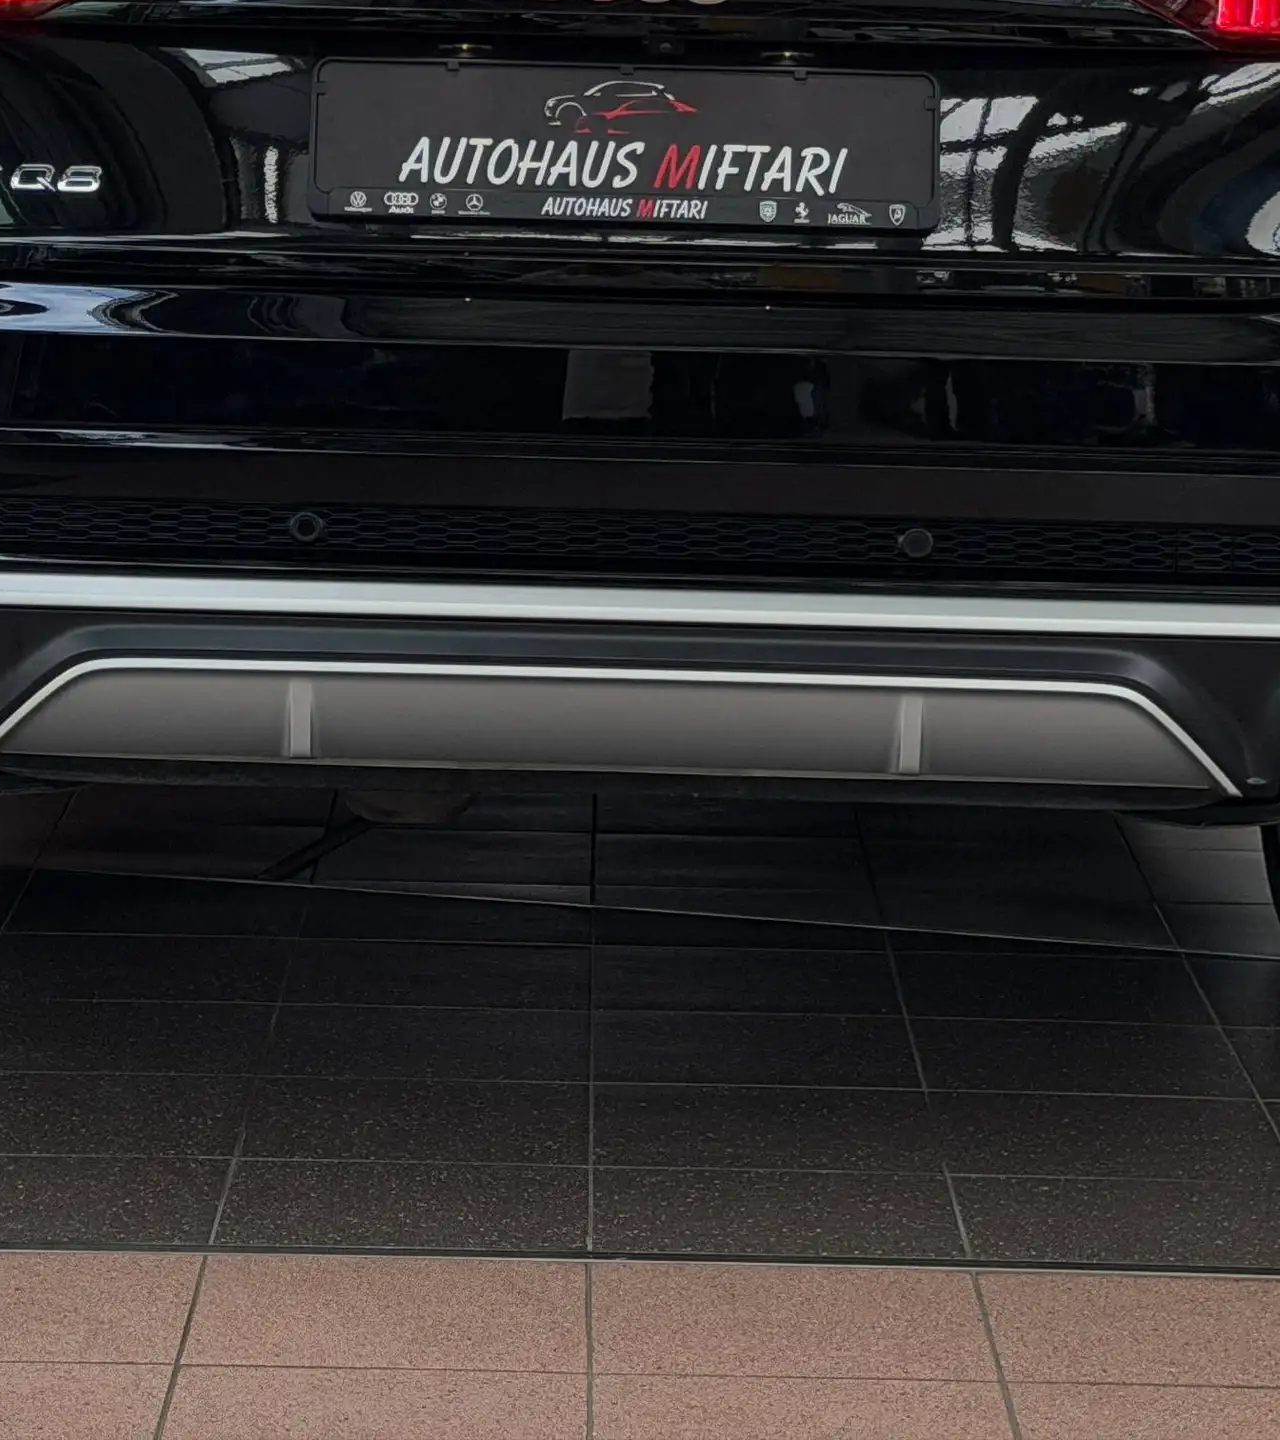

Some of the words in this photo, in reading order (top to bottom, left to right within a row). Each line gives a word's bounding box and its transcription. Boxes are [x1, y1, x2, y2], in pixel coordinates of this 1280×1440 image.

[398, 136, 646, 189] AUTOHAUS
[653, 143, 849, 197] MIFTARI
[540, 196, 633, 218] AUTOHAUS
[636, 198, 709, 220] MIFTARI
[827, 213, 868, 225] JAGUAR
